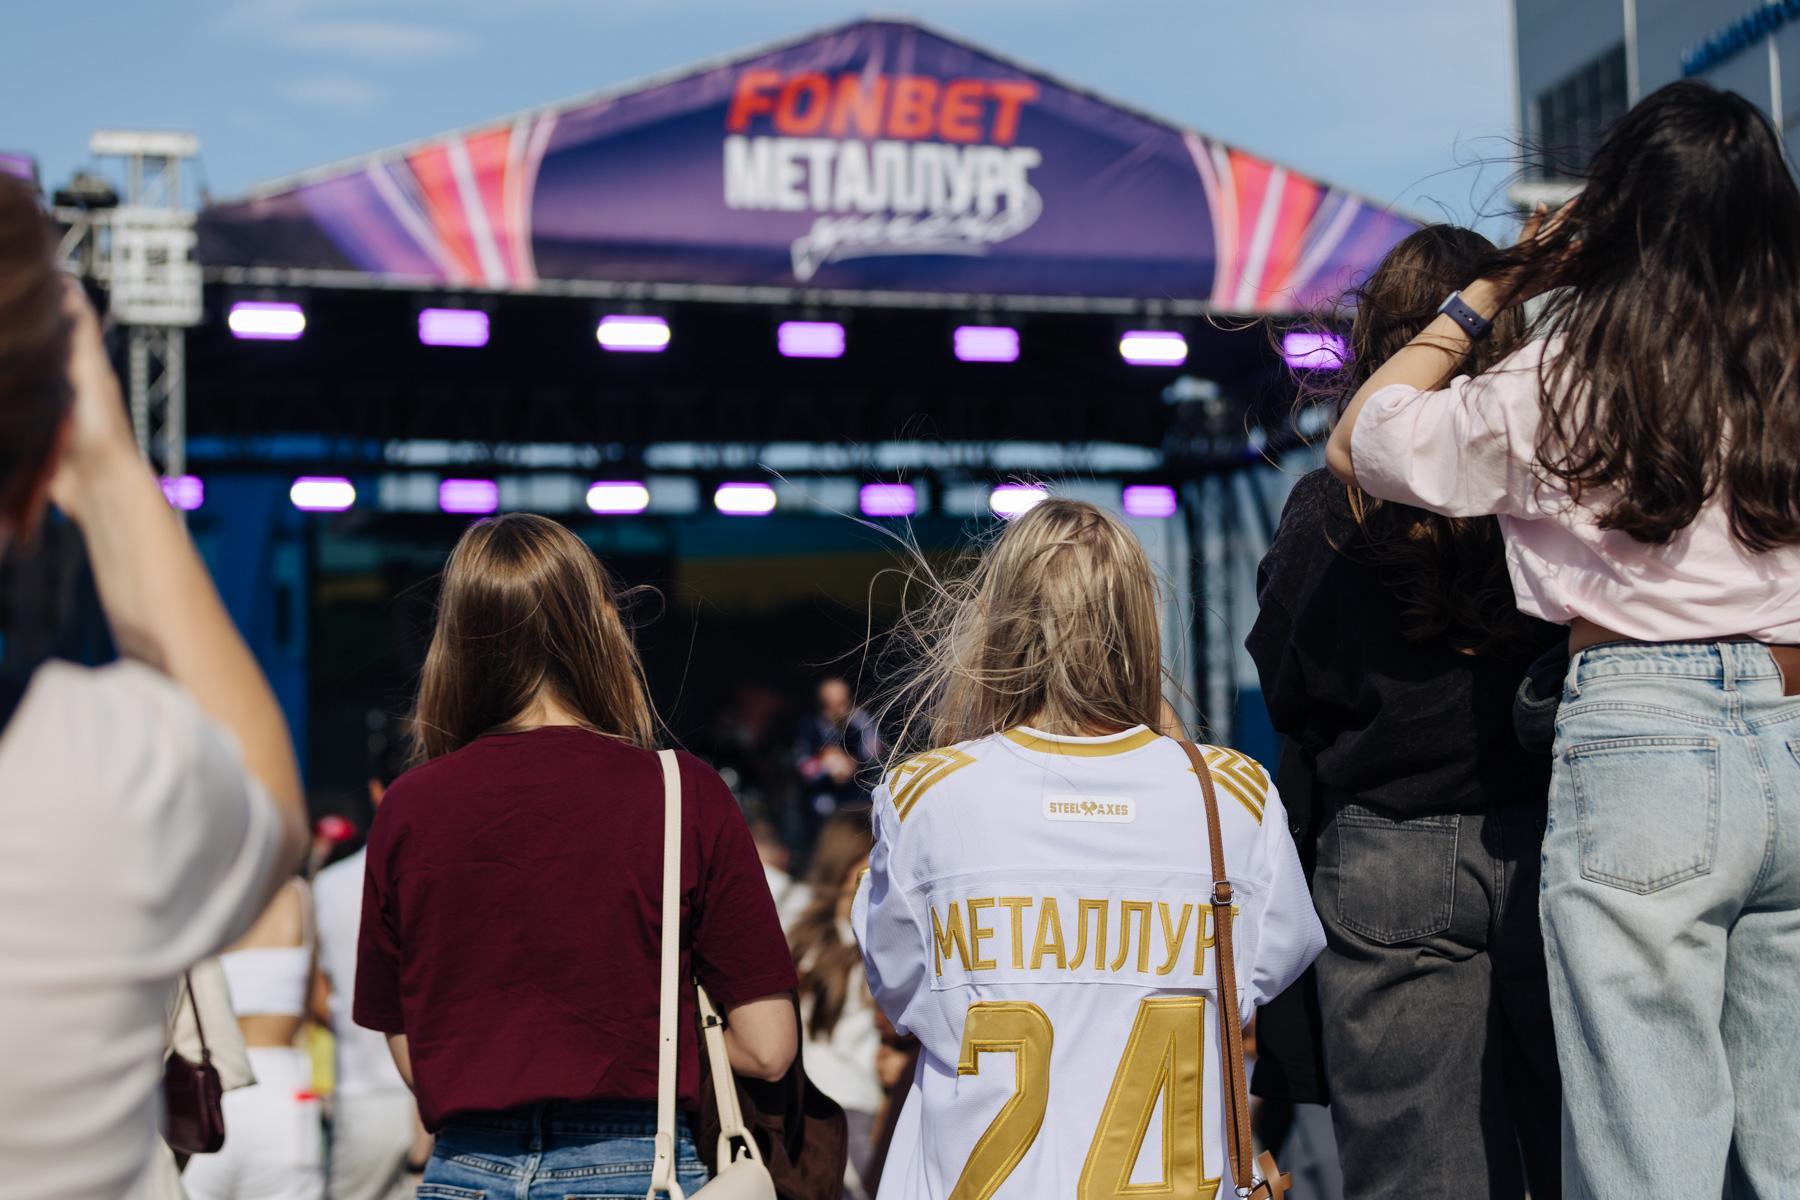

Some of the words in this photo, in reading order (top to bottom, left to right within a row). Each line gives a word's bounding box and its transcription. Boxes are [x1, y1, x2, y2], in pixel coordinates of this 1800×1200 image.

[725, 69, 1040, 145] FONBET
[1049, 802, 1081, 814] STEEL
[1097, 804, 1129, 816] AXES
[930, 895, 1240, 977] МЕТАЛЛУР
[948, 996, 1222, 1200] 24
